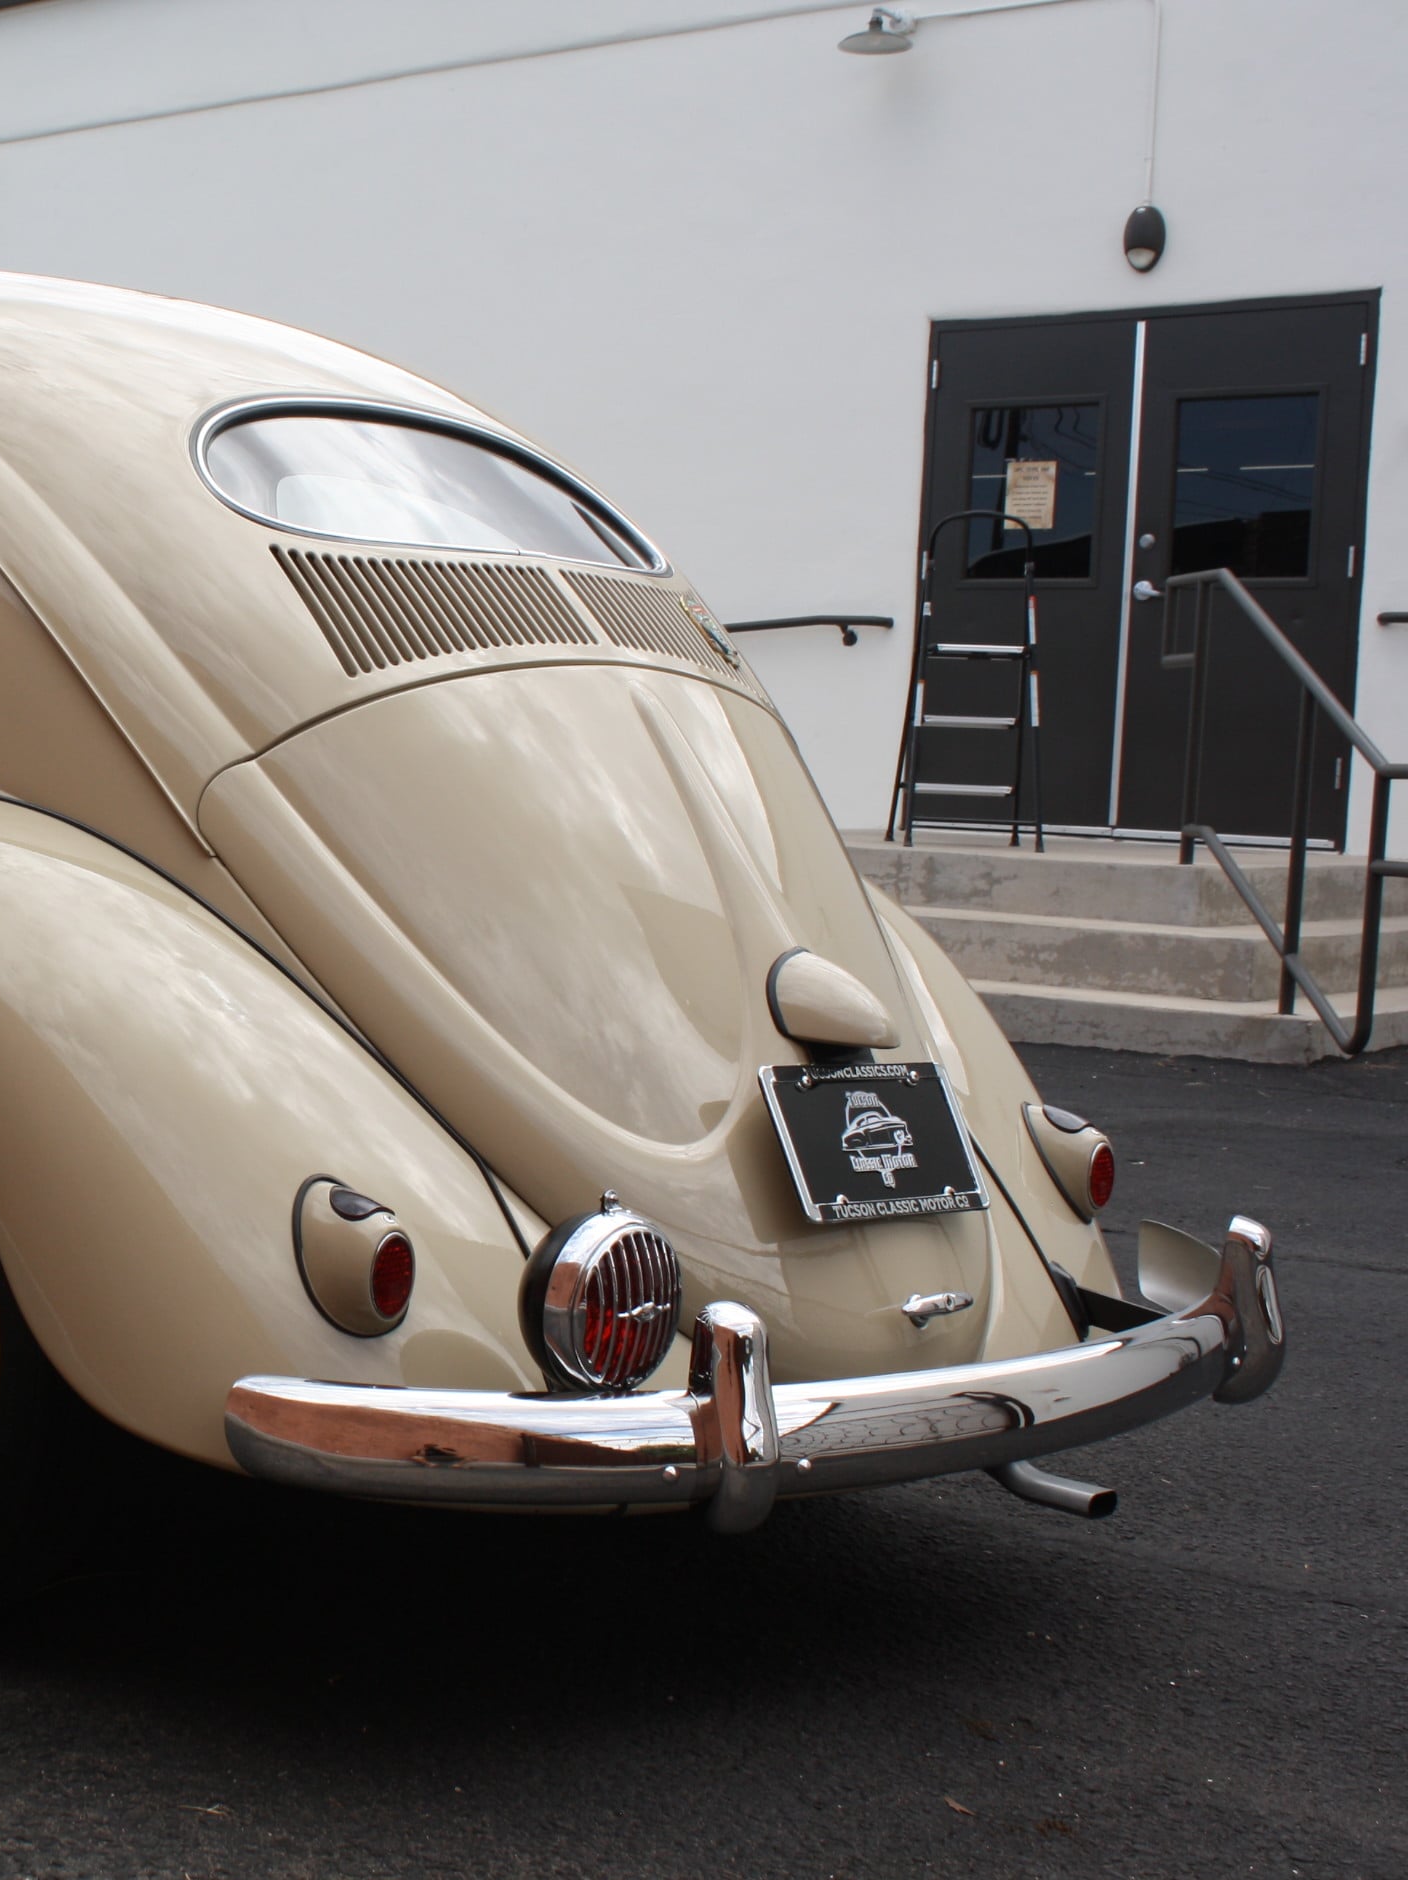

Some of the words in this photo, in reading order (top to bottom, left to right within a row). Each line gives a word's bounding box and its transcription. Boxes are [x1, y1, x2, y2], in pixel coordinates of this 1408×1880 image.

[832, 1203, 876, 1219] TUCSON
[876, 1199, 919, 1215] CLASSIC
[919, 1196, 956, 1212] MOTOR
